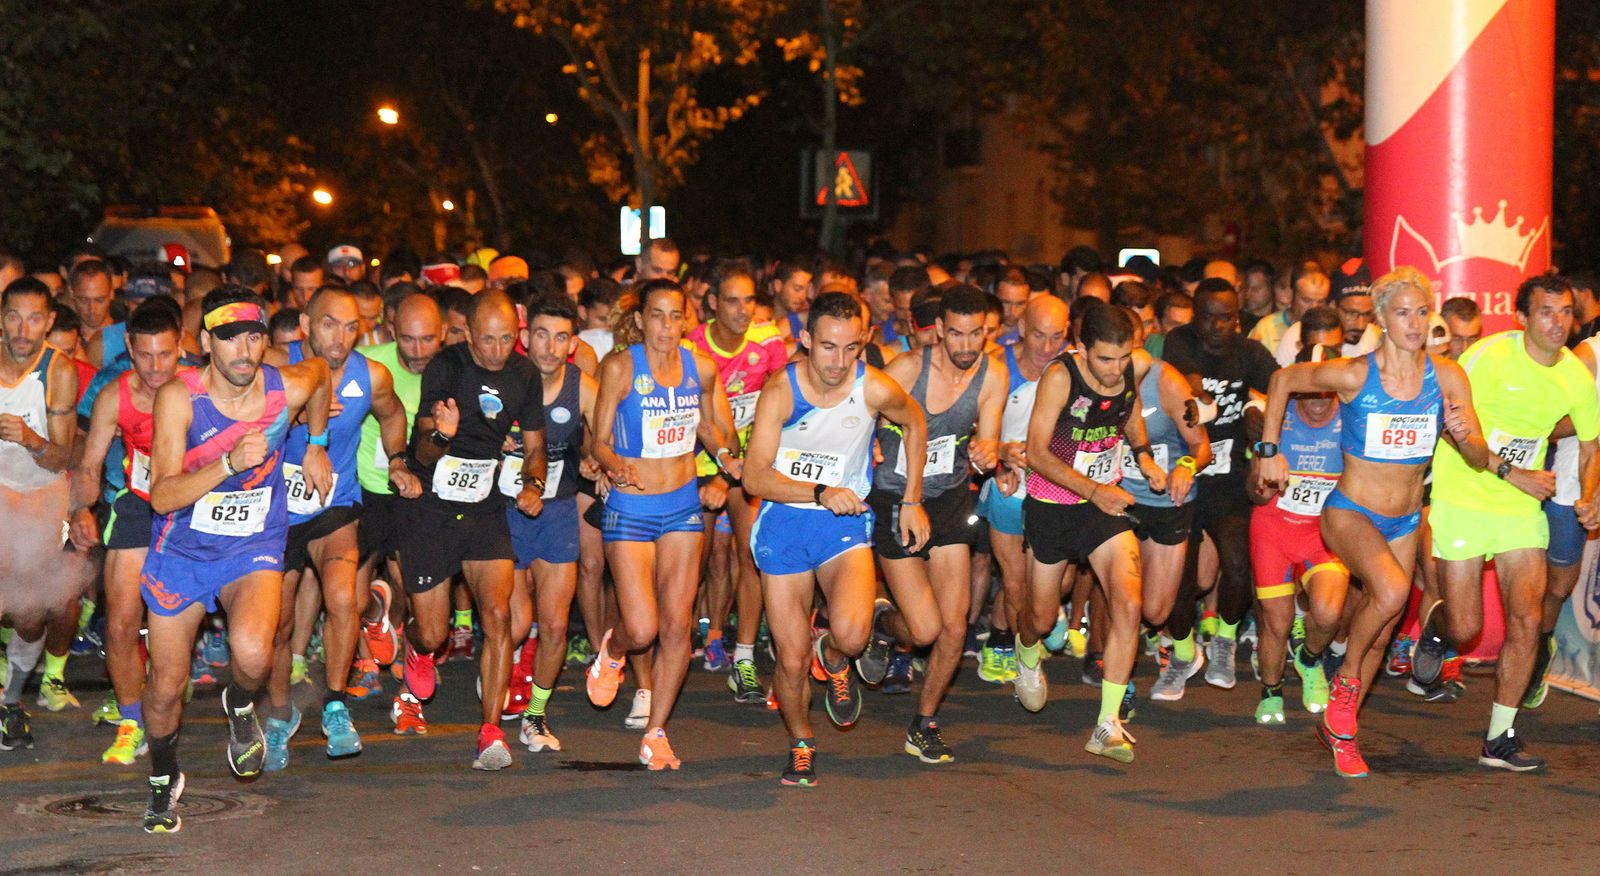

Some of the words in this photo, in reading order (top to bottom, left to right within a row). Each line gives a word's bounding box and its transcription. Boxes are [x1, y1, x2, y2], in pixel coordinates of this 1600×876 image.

[640, 396, 667, 408] ANA
[676, 393, 699, 406] DIAS
[643, 407, 698, 417] RUNNE
[732, 406, 746, 419] 17
[657, 426, 685, 445] 803
[1382, 429, 1417, 446] 629
[800, 451, 839, 462] NOCTURNA
[1296, 454, 1327, 472] PEREZ
[1498, 447, 1527, 465] 654
[790, 461, 824, 480] 647
[1087, 459, 1112, 478] 613
[447, 472, 479, 489] 382
[224, 490, 264, 500] NOCTURNA
[1292, 487, 1320, 504] 621
[211, 505, 249, 521] 625
